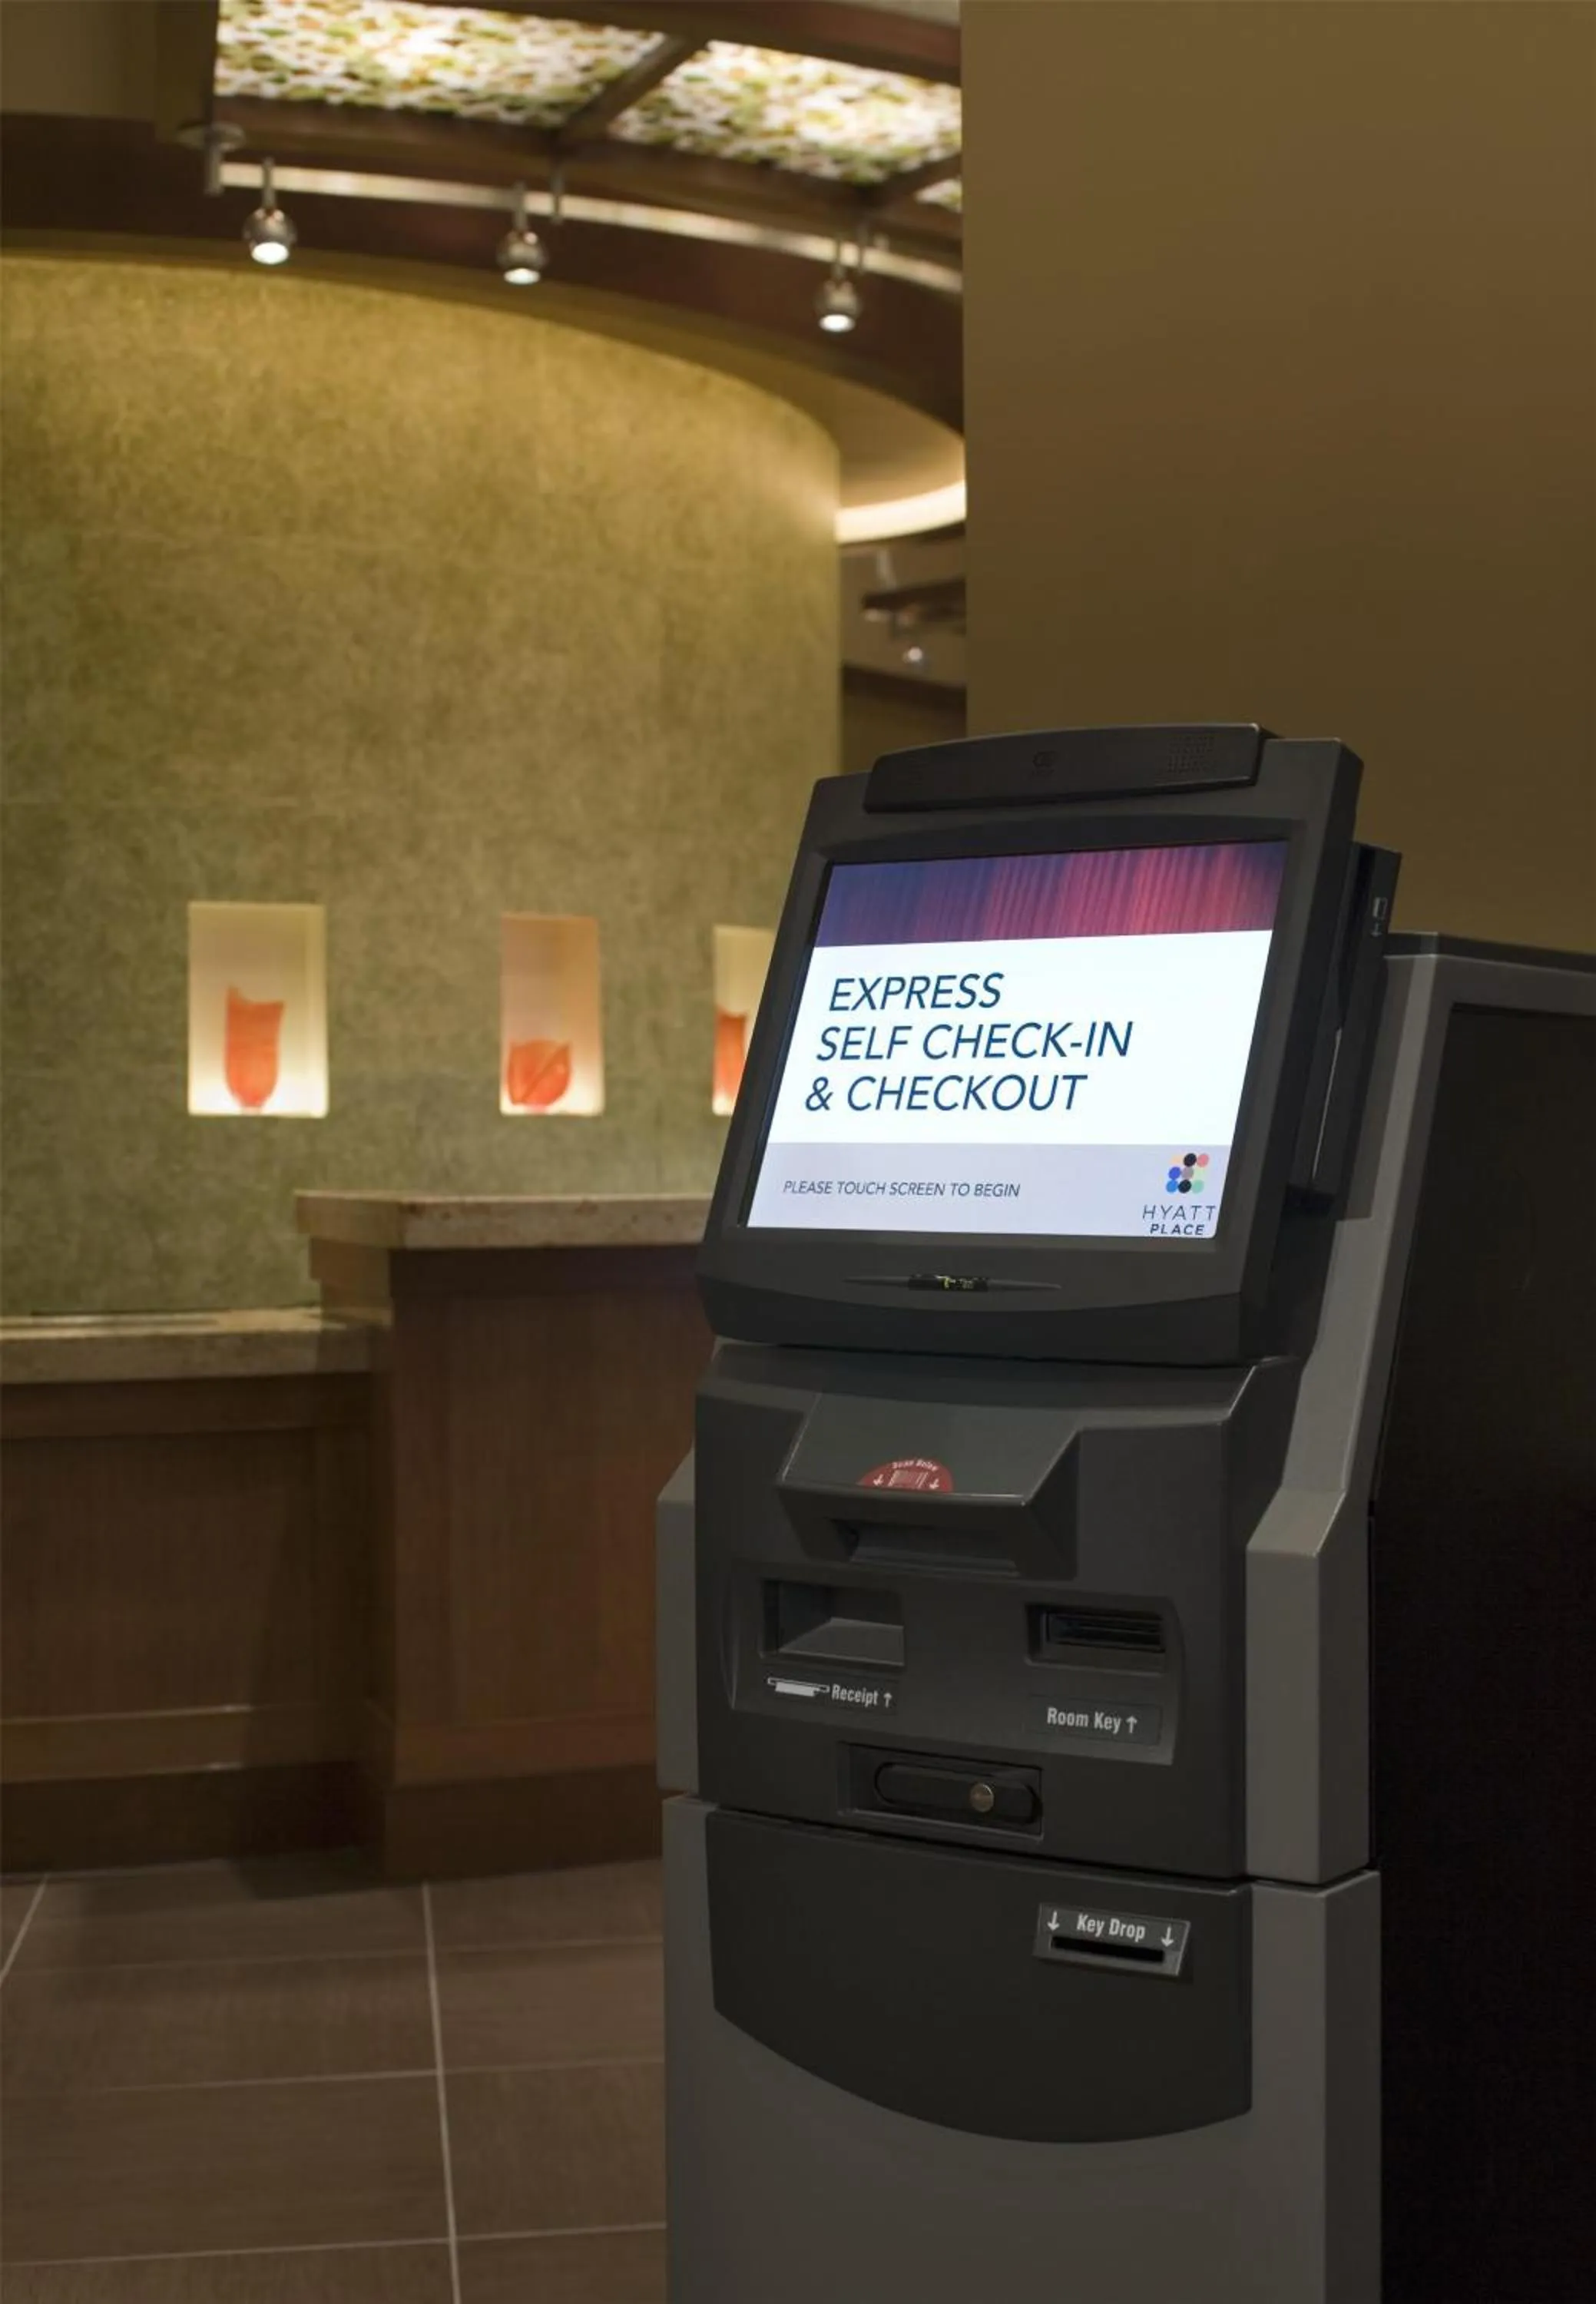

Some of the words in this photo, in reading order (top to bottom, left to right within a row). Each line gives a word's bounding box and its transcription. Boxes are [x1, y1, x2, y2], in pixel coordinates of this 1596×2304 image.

[829, 972, 1005, 1011] EXPRESS
[816, 1025, 913, 1061] SELF
[922, 1021, 1134, 1061] CHECK-IN
[805, 1076, 833, 1111] &
[847, 1074, 1088, 1111] CHECKOUT
[783, 1180, 833, 1194] PLEASE
[837, 1180, 887, 1195] TOUCH
[889, 1181, 946, 1197] SCREEN
[951, 1182, 970, 1197] TO
[973, 1183, 1021, 1197] BEGIN
[1142, 1204, 1216, 1221] HYATT
[1150, 1223, 1205, 1236] PLACE
[831, 1683, 879, 1707] Receipt
[1047, 1706, 1089, 1727] Room
[1094, 1711, 1121, 1734] Key
[1076, 1913, 1105, 1938] Key
[1108, 1918, 1146, 1943] Drop
